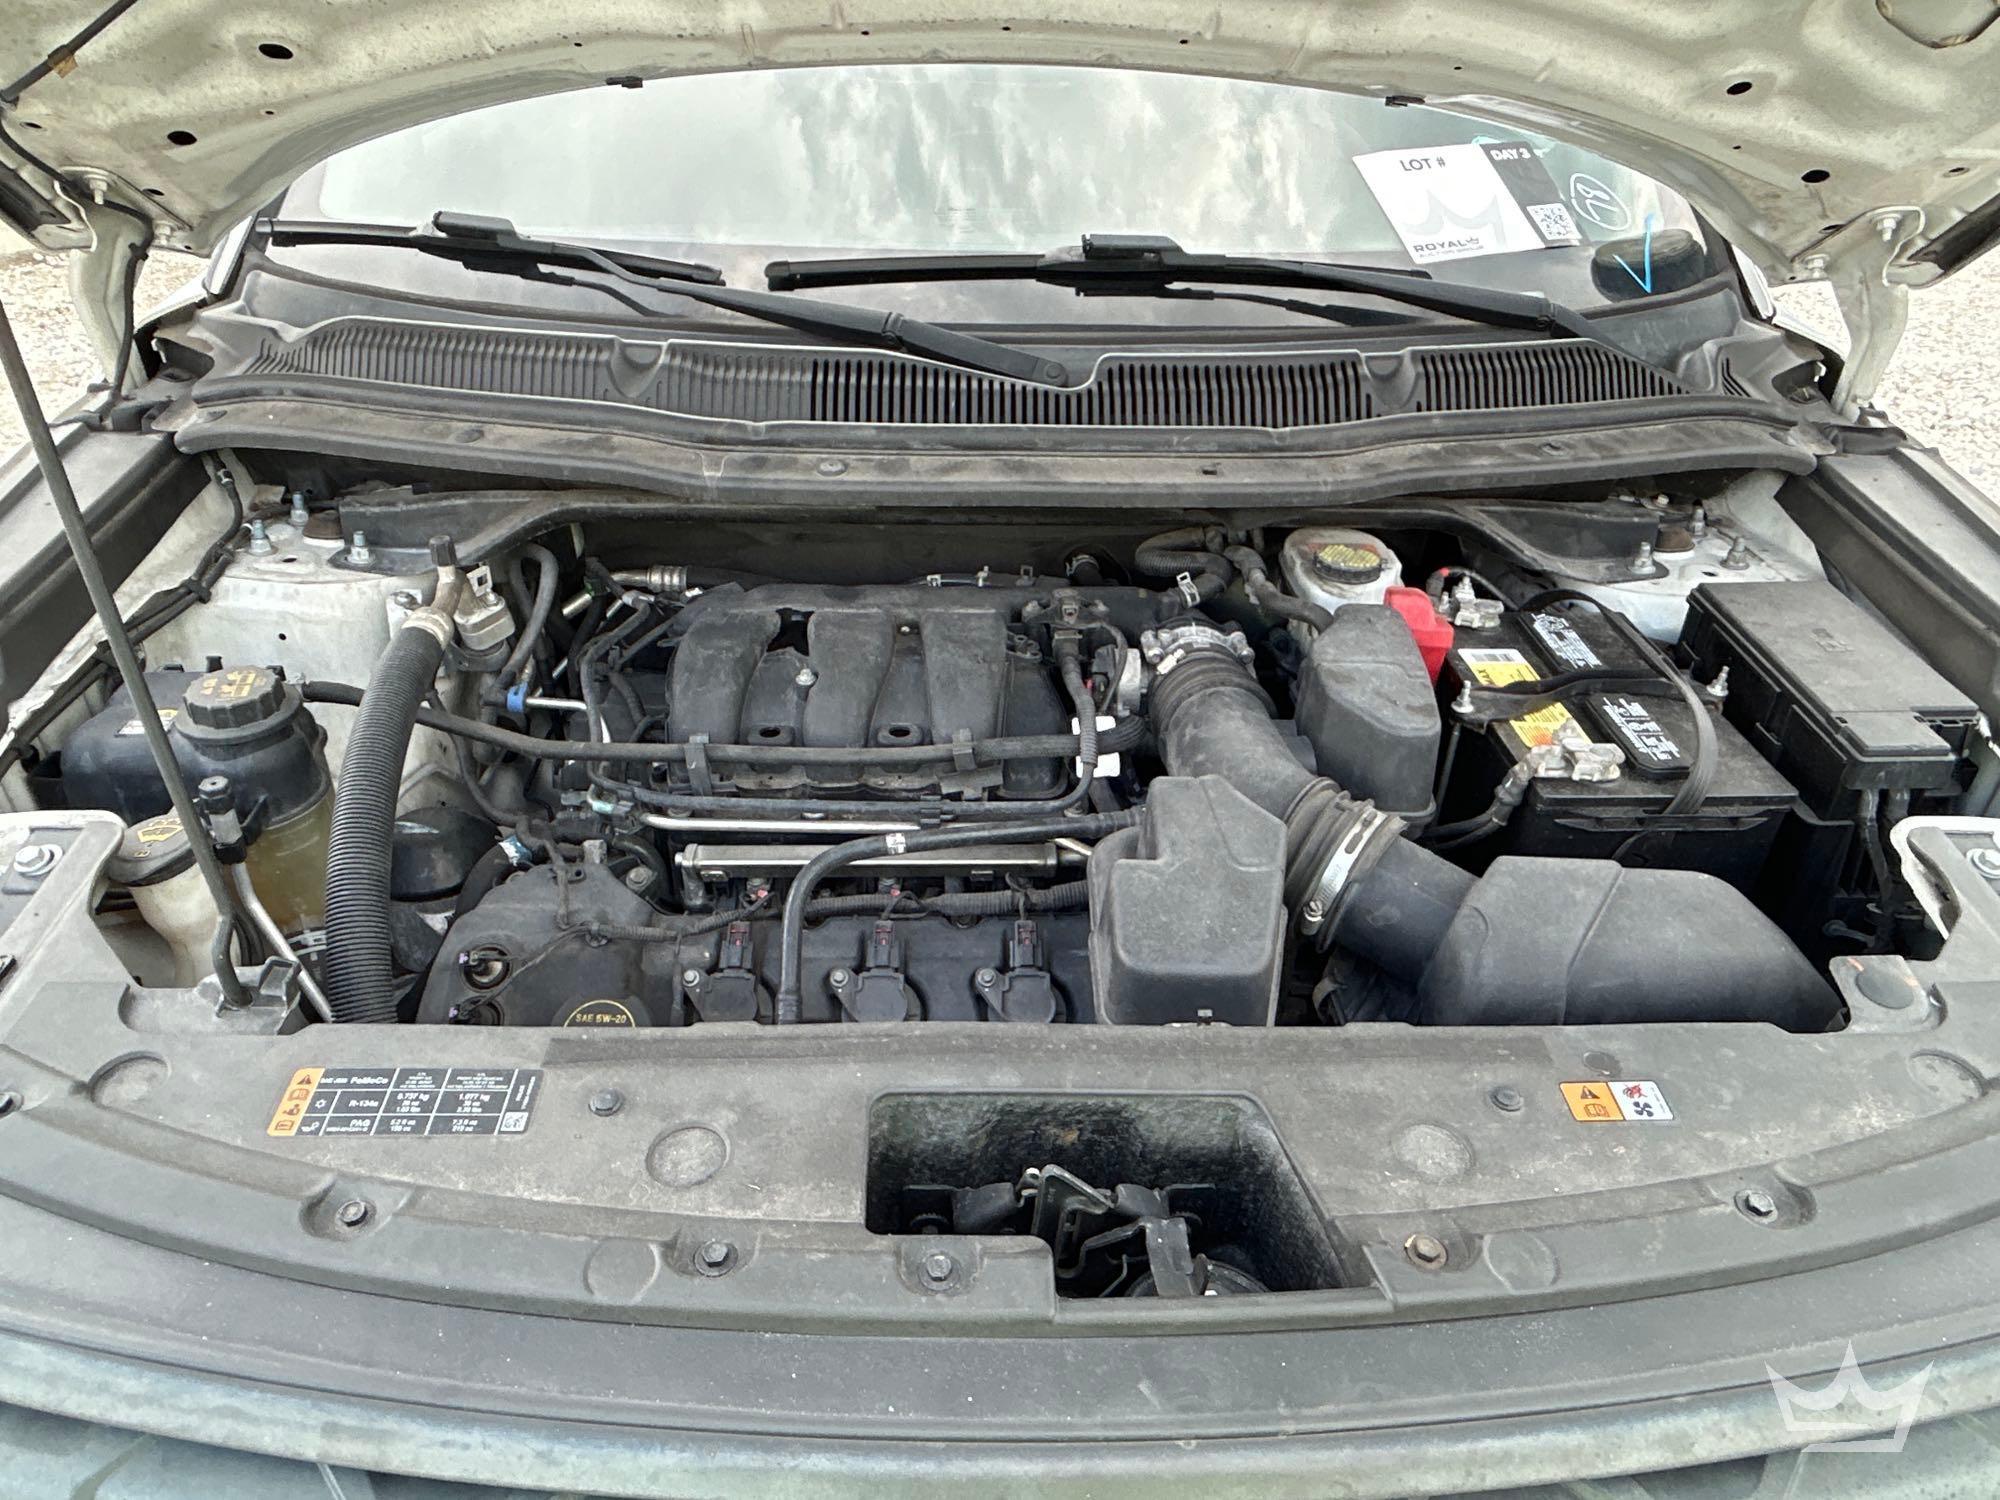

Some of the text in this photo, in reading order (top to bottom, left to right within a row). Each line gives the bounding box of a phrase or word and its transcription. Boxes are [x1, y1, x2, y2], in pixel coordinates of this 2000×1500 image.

[1490, 147, 1531, 160] DAY 3
[1399, 156, 1446, 171] LOT #
[1413, 239, 1468, 252] ROYAL
[575, 1013, 627, 1024] SAE 5W-20
[348, 1099, 379, 1108] R-134a
[350, 1118, 371, 1127] PAG
